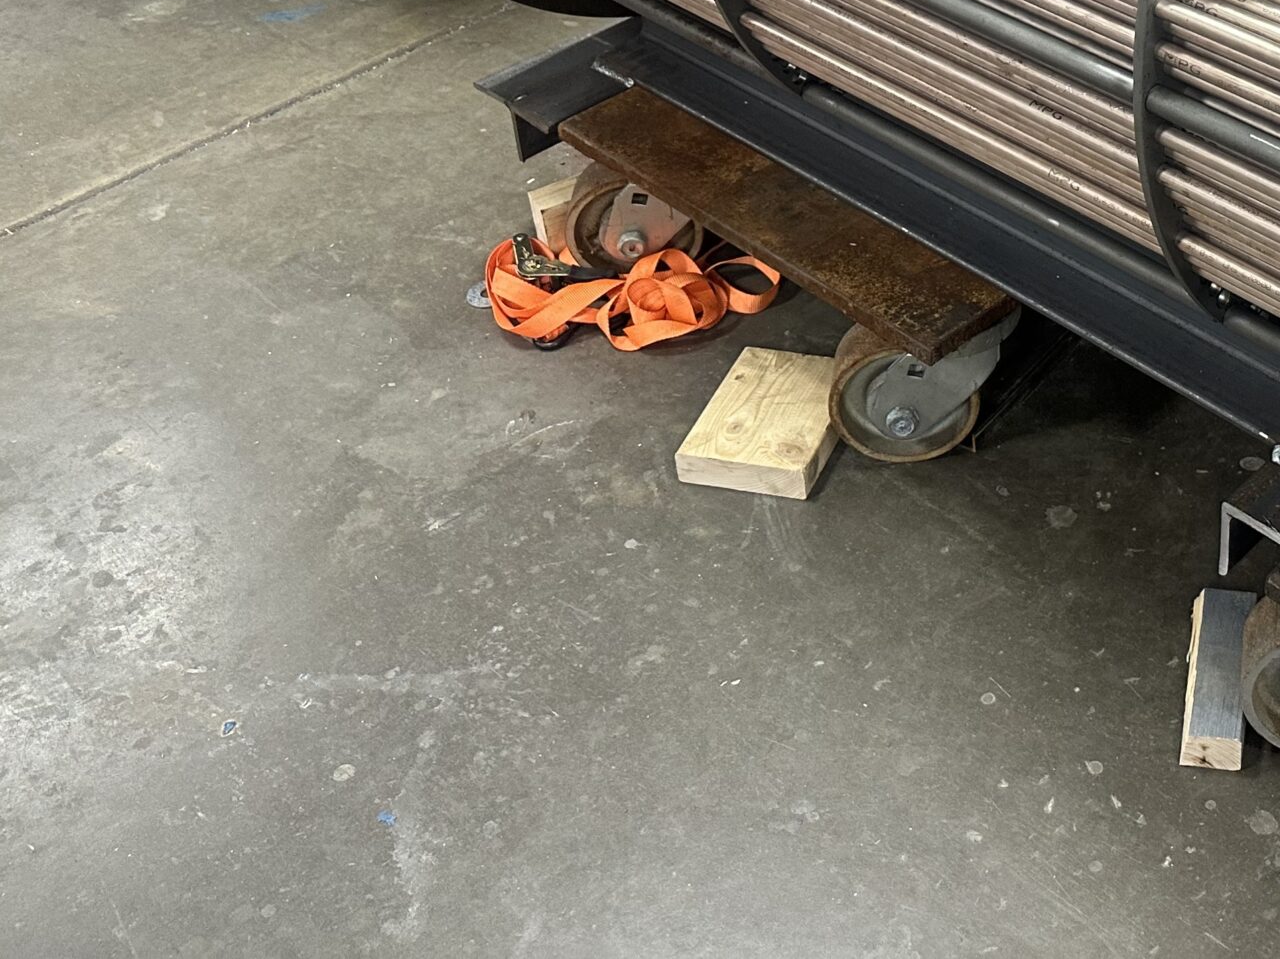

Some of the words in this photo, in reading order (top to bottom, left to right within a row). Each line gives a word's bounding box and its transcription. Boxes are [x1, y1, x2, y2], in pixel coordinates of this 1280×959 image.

[1163, 52, 1203, 76] MPG
[1028, 98, 1064, 121] MPG
[1047, 167, 1082, 192] MPG
